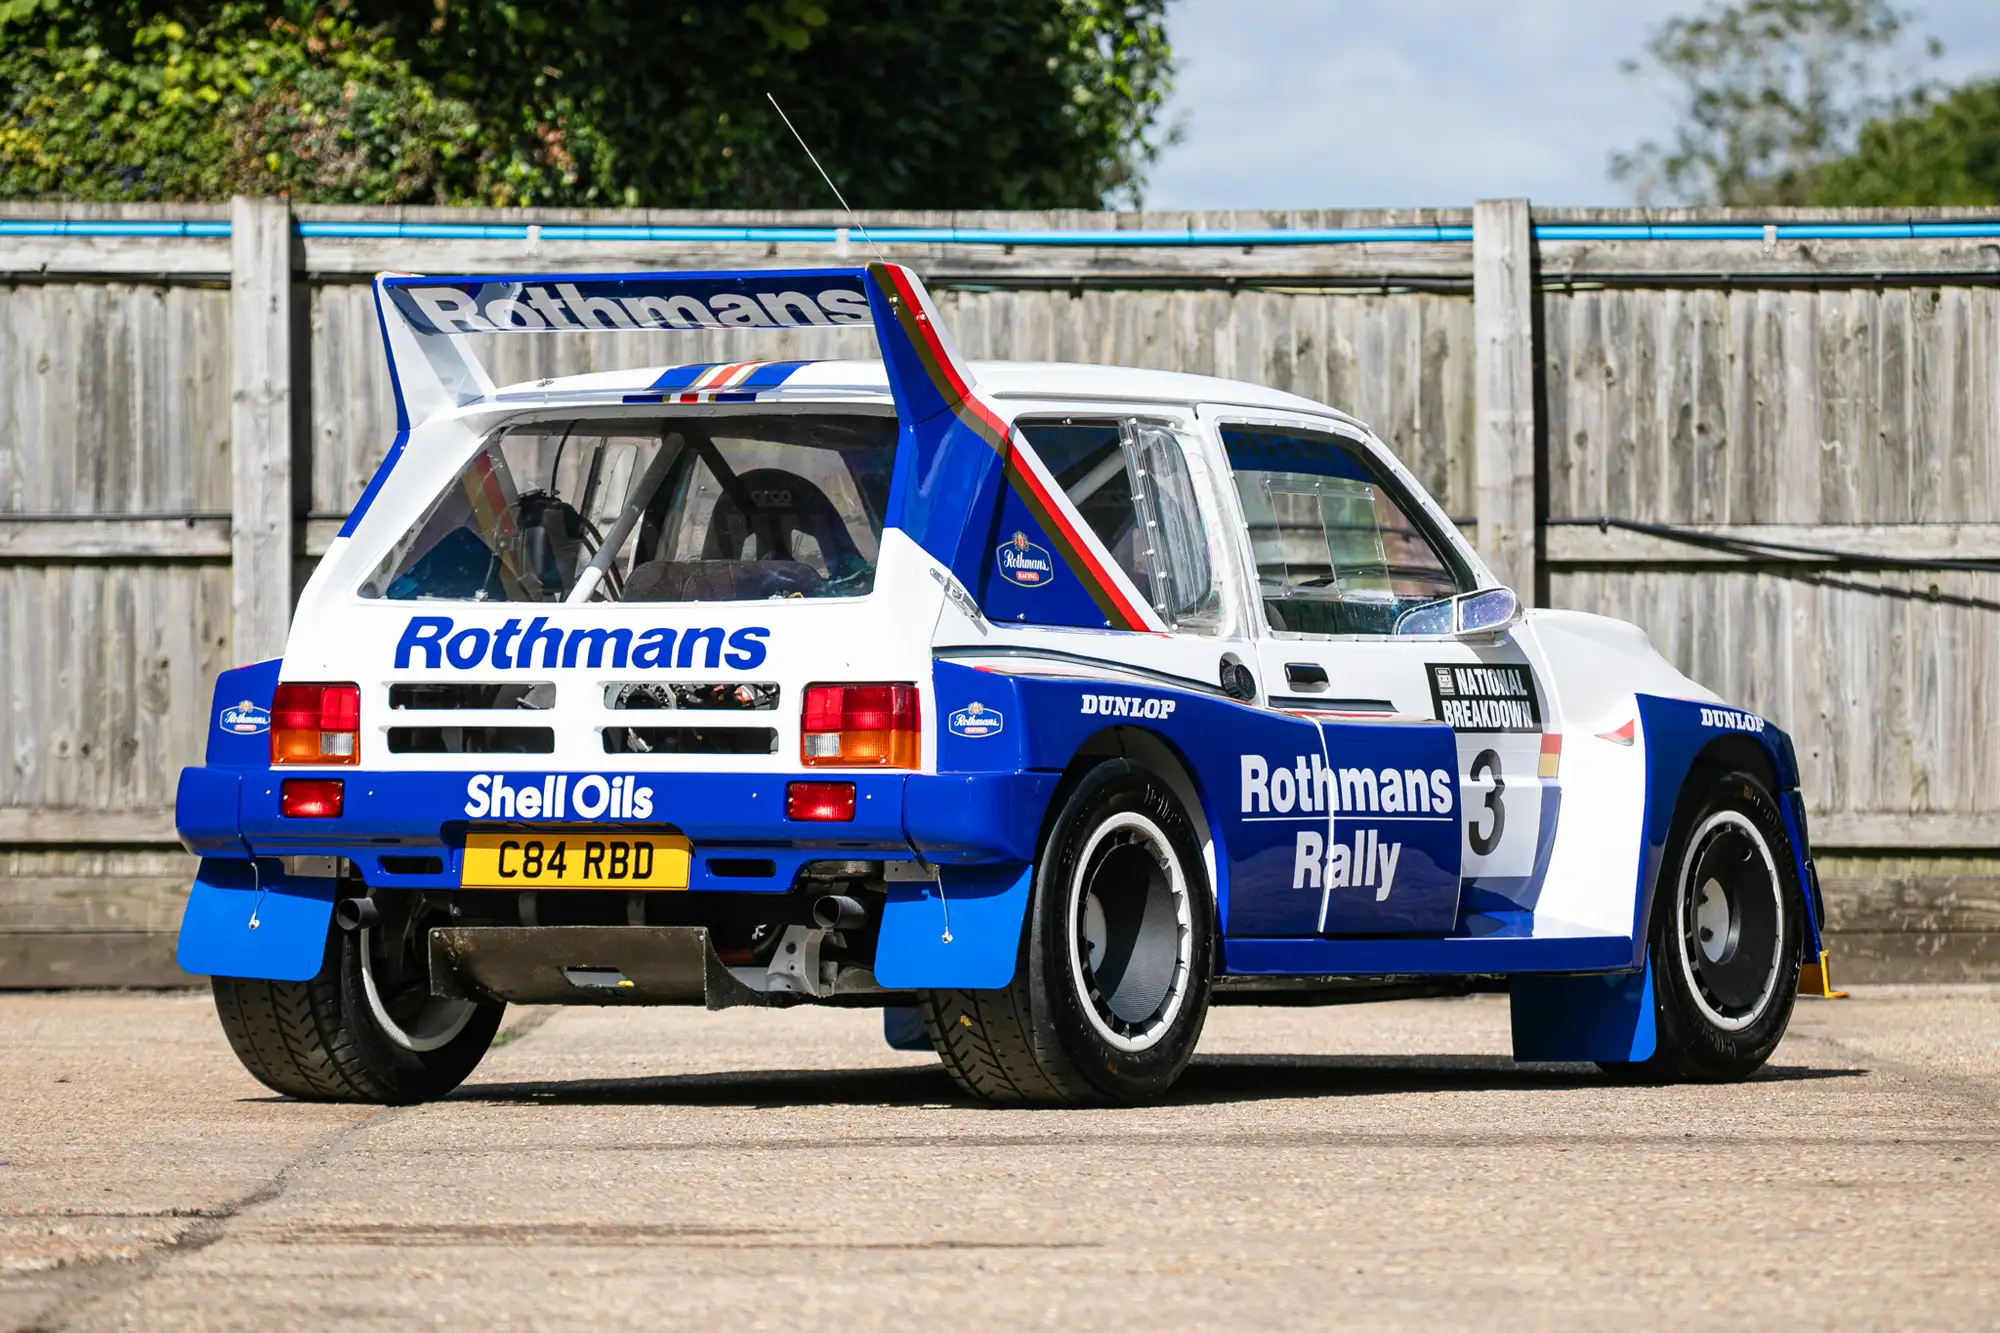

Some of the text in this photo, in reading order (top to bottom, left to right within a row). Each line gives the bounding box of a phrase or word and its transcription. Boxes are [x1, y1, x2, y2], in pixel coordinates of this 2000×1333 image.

[407, 283, 874, 333] Rothmans
[1003, 549, 1049, 571] Rothmans
[394, 617, 770, 670] Rothmans
[1455, 668, 1528, 696] NATIONAL
[224, 711, 268, 725] Rothmans
[954, 713, 1000, 727] Rothmans
[1081, 694, 1176, 719] DUNLOP
[1441, 700, 1533, 728] BREAKDOWN
[1700, 708, 1764, 732] DUNLOP
[465, 775, 654, 819] Shell Oils
[1241, 754, 1453, 814] Rothmans
[1469, 749, 1505, 856] 3
[499, 840, 655, 880] C84 RBD
[1293, 830, 1401, 902] Rally
